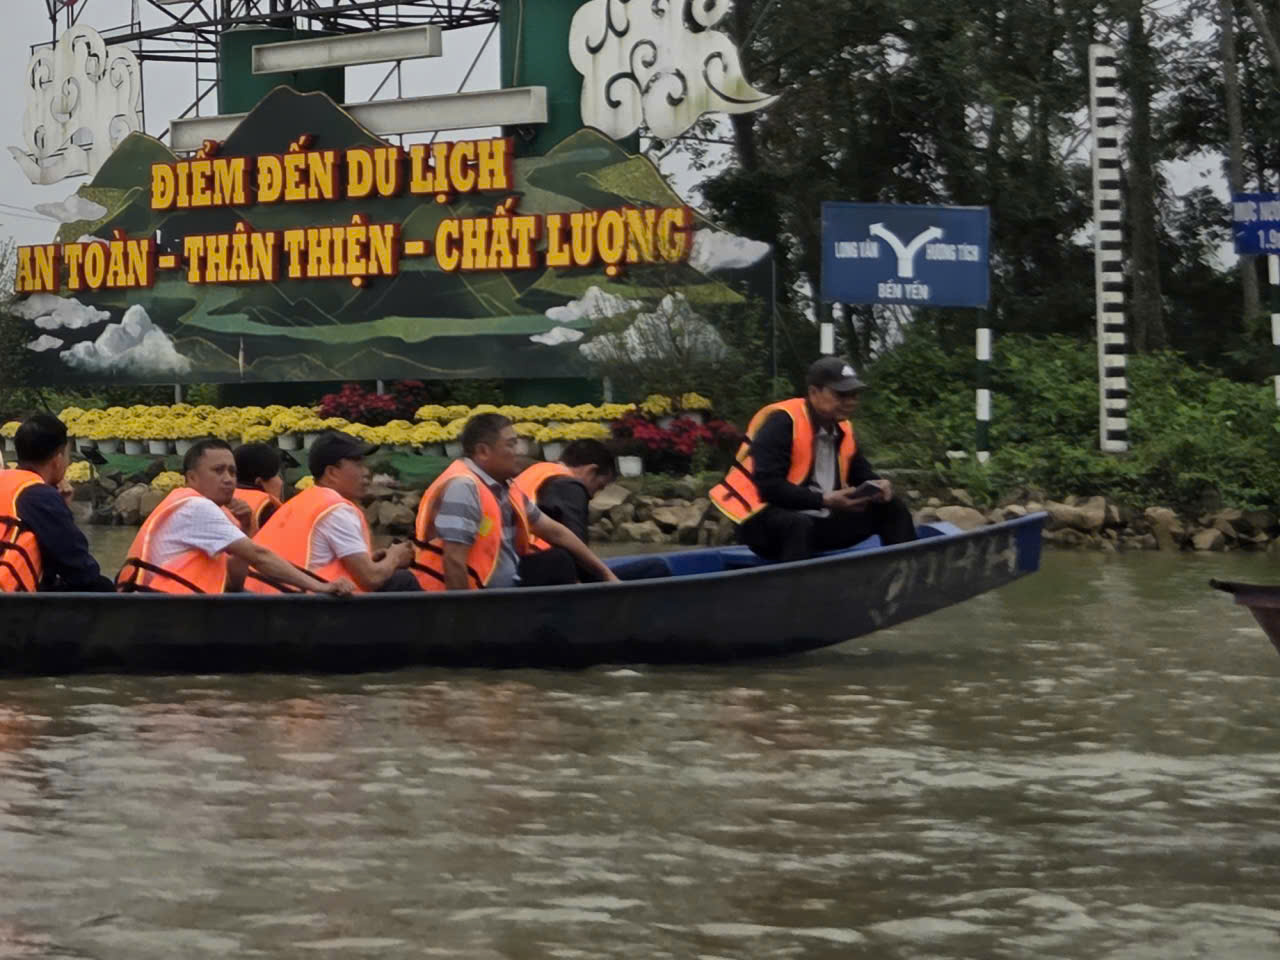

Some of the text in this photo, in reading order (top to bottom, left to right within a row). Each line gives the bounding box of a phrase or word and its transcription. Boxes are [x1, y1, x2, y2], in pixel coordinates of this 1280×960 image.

[151, 135, 508, 209] ĐIỂM ĐẾN DU LỊCH
[18, 245, 55, 292] AN
[64, 229, 150, 290] TOÀN
[184, 222, 276, 284] THÂN
[284, 214, 395, 288] THIỆN
[435, 198, 537, 272] CHẤT
[546, 206, 696, 276] LƯỢNG
